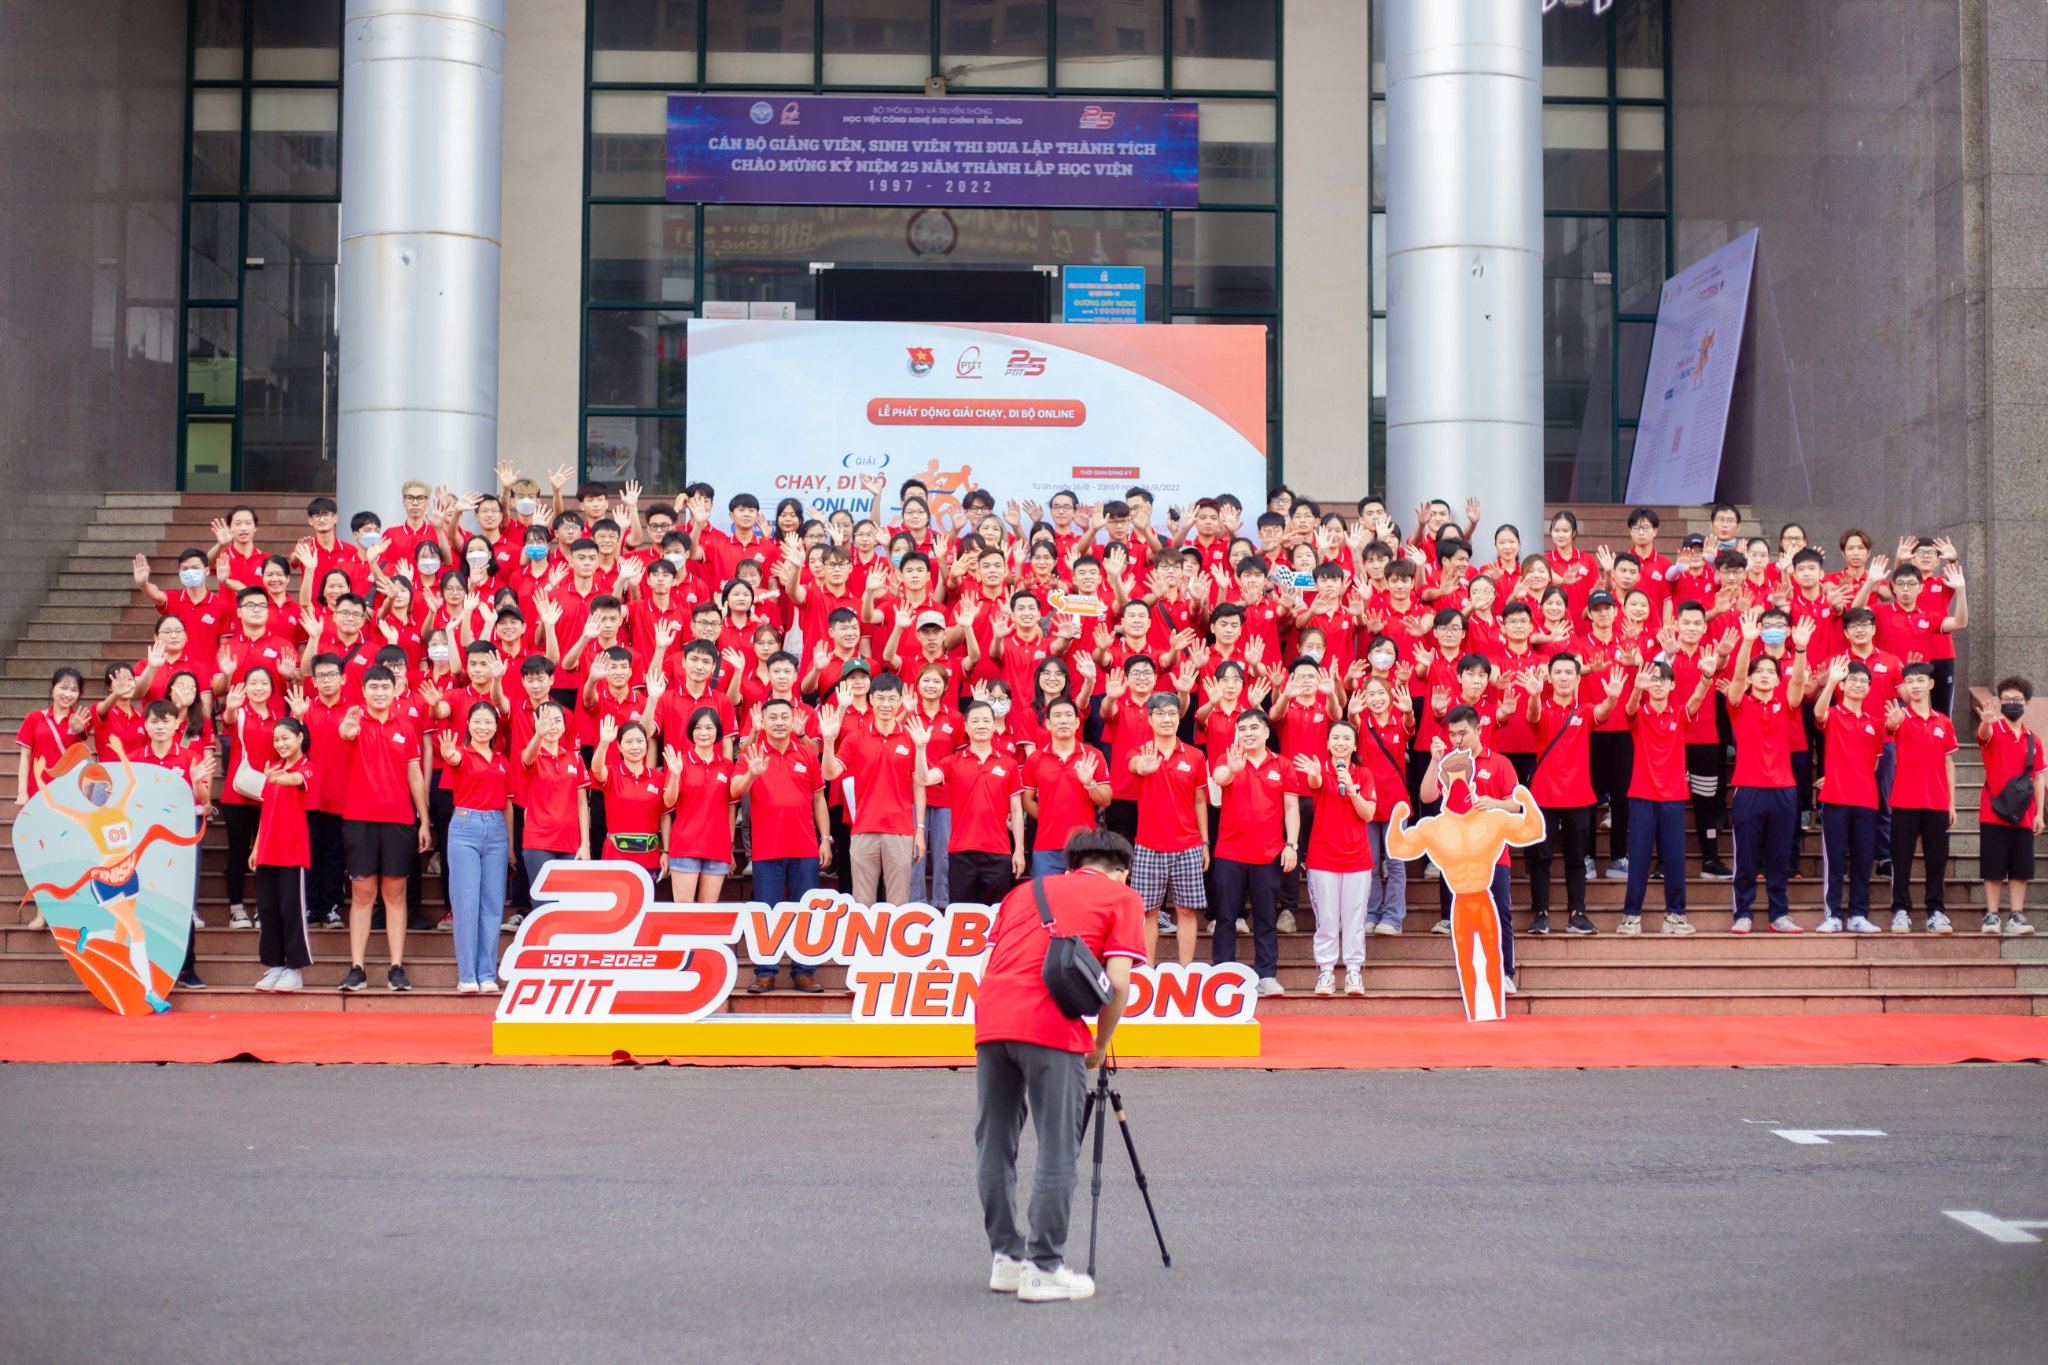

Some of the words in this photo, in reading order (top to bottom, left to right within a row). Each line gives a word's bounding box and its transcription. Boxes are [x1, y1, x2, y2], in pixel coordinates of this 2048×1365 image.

[709, 136, 743, 150] CÁN
[745, 136, 766, 154] BỘ
[769, 136, 819, 151] GIẢNG
[822, 137, 865, 153] VIÊN,
[869, 140, 908, 152] SINH
[912, 138, 950, 153] VIÊN
[954, 141, 983, 153] THI
[986, 141, 1019, 153] ĐUA
[1022, 140, 1053, 156] LẬP
[1056, 140, 1114, 155] THÀNH
[1117, 141, 1156, 155] TÍCH
[731, 157, 776, 172] CHÀO
[779, 157, 826, 172] MỪNG
[856, 159, 898, 175] NIỆM
[901, 161, 918, 173] 25
[921, 159, 960, 174] NĂM
[962, 160, 1021, 174] THÀNH
[1024, 160, 1055, 177] LẬP
[1058, 163, 1091, 177] HỌC
[1094, 161, 1133, 177] VIỆN
[869, 179, 912, 192] 1997
[946, 180, 991, 193] 2022
[1007, 350, 1048, 376] 25
[878, 403, 890, 417] LỄ
[892, 405, 918, 417] PHÁT
[920, 406, 951, 420] ĐỘNG
[952, 406, 973, 417] GIẢI
[1008, 409, 1019, 418] ĐI
[1021, 407, 1035, 420] BỘ
[1037, 409, 1075, 418] ONLINE
[775, 474, 831, 494] CHẠY,
[837, 475, 856, 490] ĐI
[108, 827, 127, 842] 01
[90, 852, 136, 883] FINISH
[750, 898, 936, 957] VỮNG
[522, 869, 739, 1014] 25
[542, 953, 658, 967] 1997-2022
[505, 979, 614, 1014] PTIT
[1122, 972, 1245, 1018] ONG
